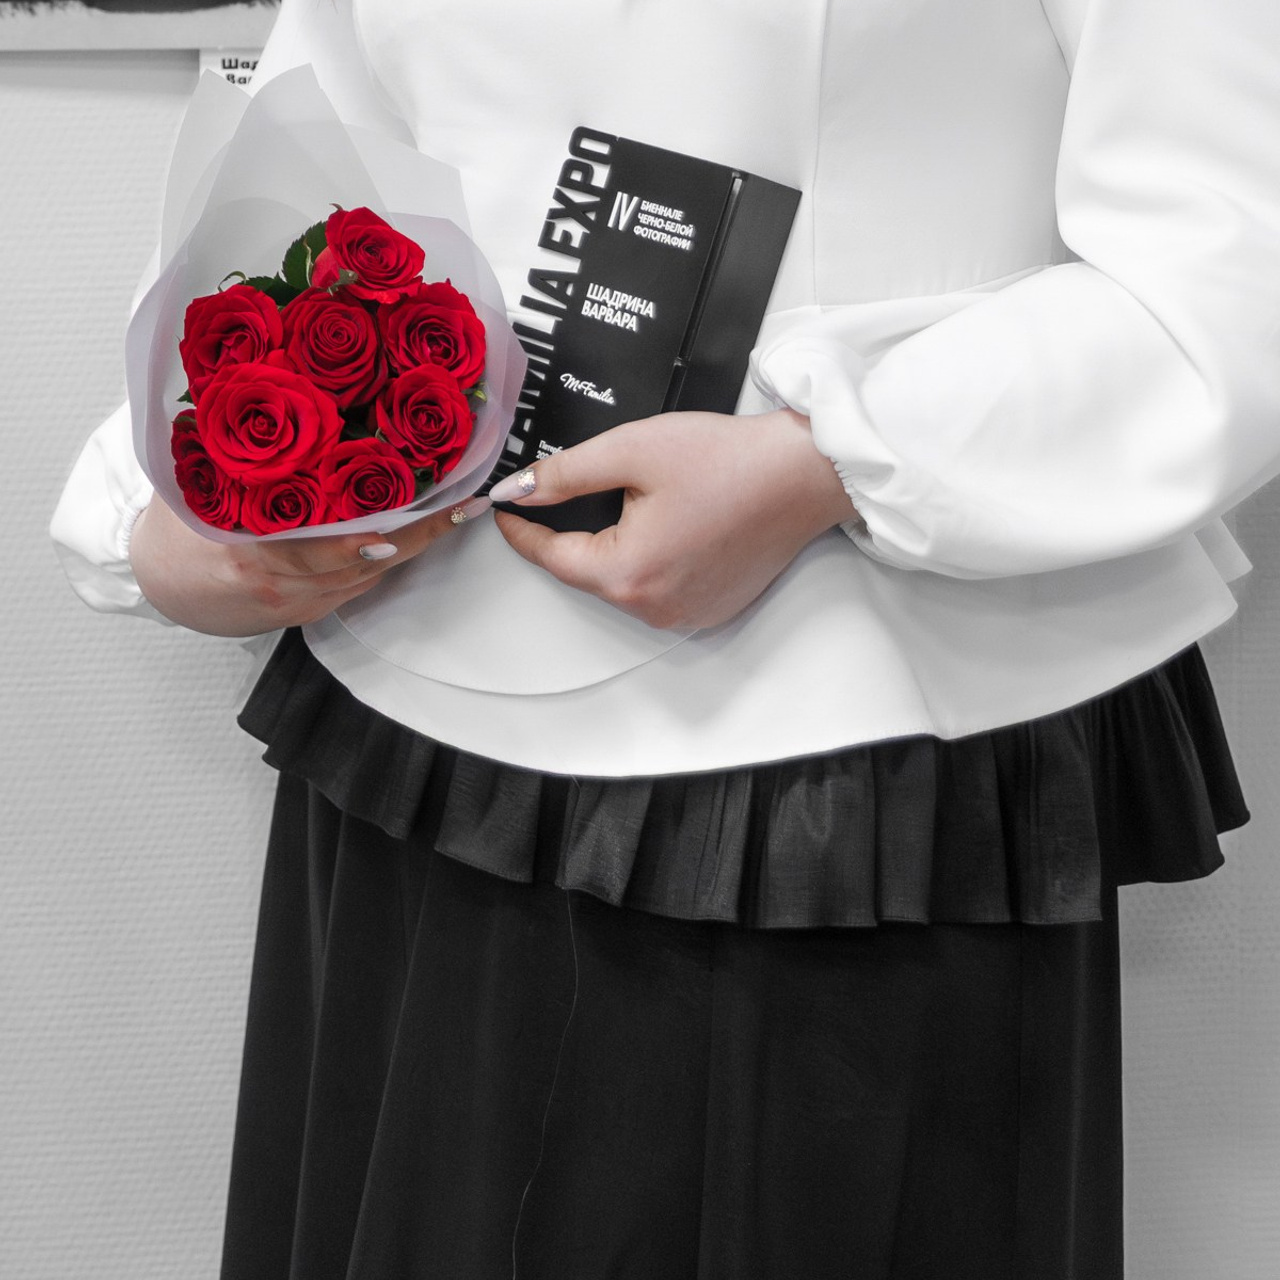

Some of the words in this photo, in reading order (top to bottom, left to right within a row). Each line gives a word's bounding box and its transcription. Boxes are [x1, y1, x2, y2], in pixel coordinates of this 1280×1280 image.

[537, 126, 617, 261] EXPO
[640, 200, 685, 221] БИЕННАЛЕ
[607, 191, 640, 231] IV
[637, 212, 695, 238] ЧЕРНО-БЕЛОЙ
[633, 225, 693, 251] ФОТОГРАФИИ
[581, 299, 639, 333] ВАРВАРА
[586, 282, 656, 319] ШАДРИНА
